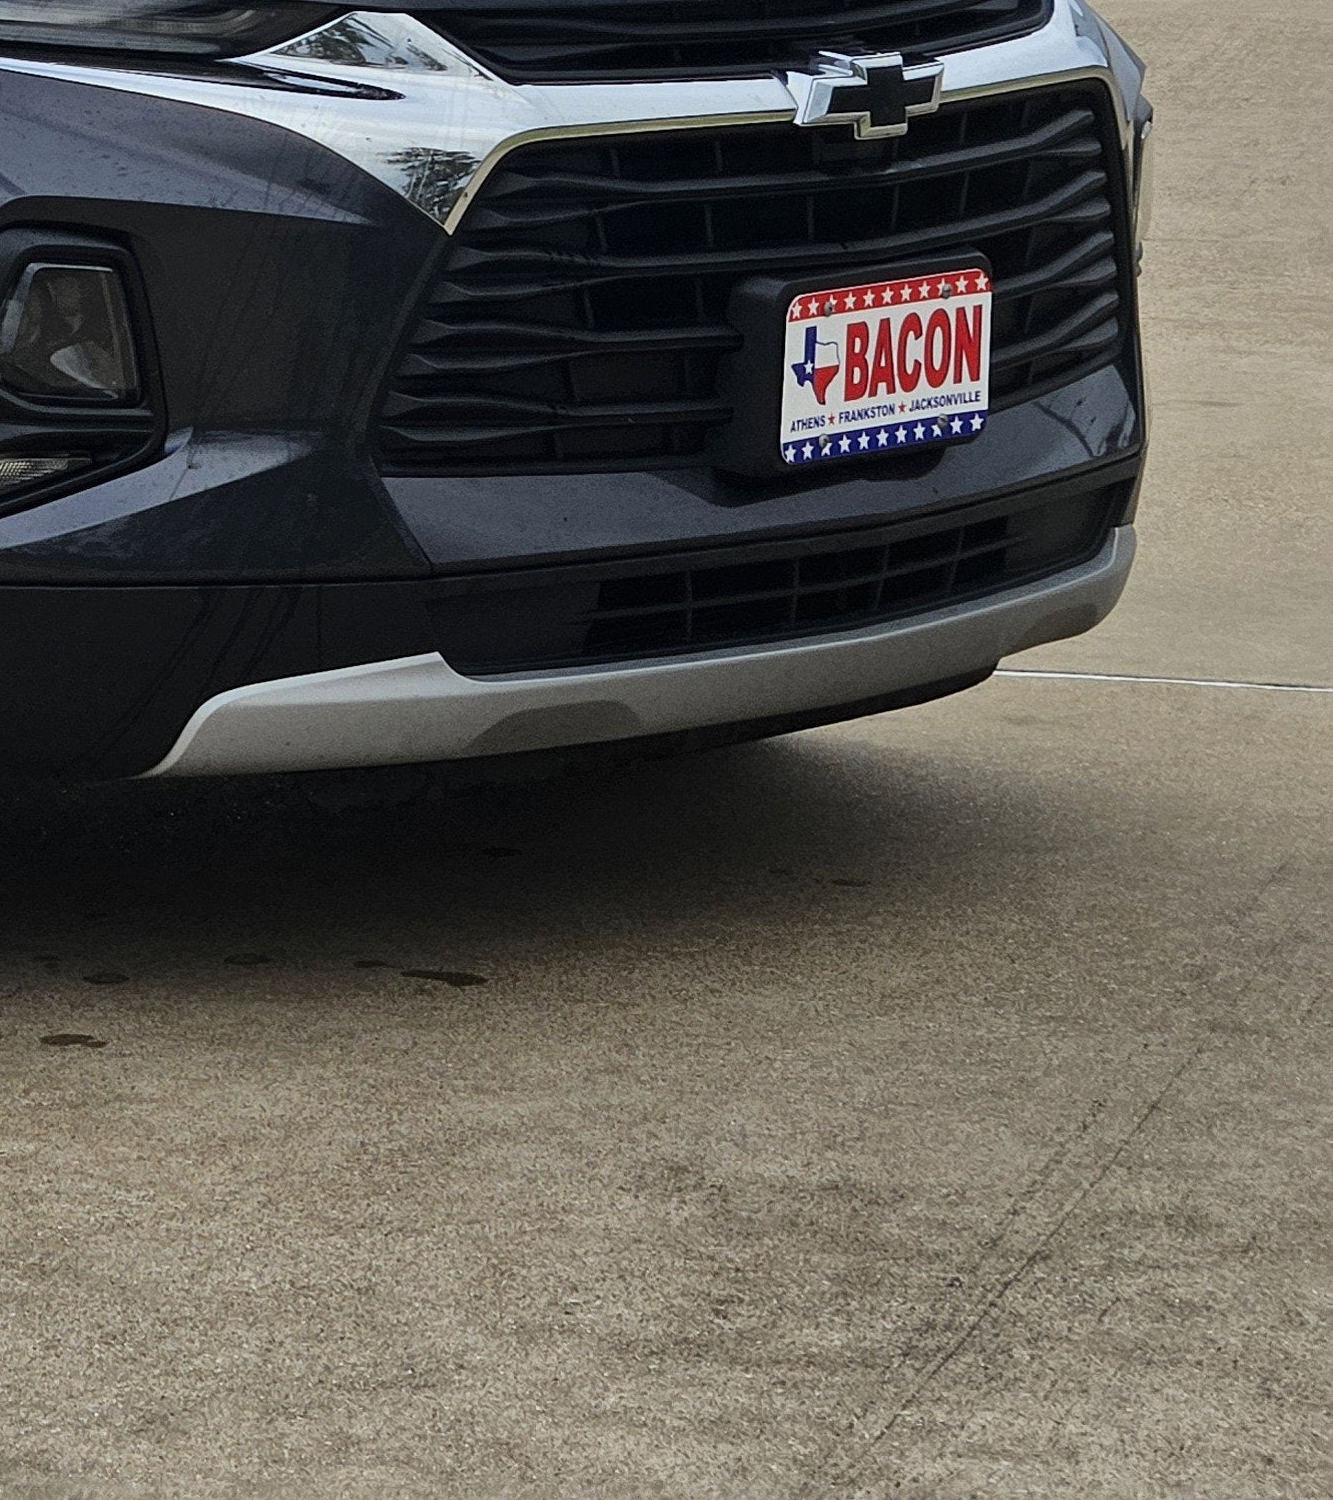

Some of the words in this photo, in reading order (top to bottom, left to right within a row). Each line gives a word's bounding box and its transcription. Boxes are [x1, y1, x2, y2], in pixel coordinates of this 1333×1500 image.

[844, 304, 983, 402] BACON
[790, 414, 826, 433] ATHENS
[838, 403, 896, 424] FRANKSTON
[909, 390, 981, 411] JACKSONVILLE
